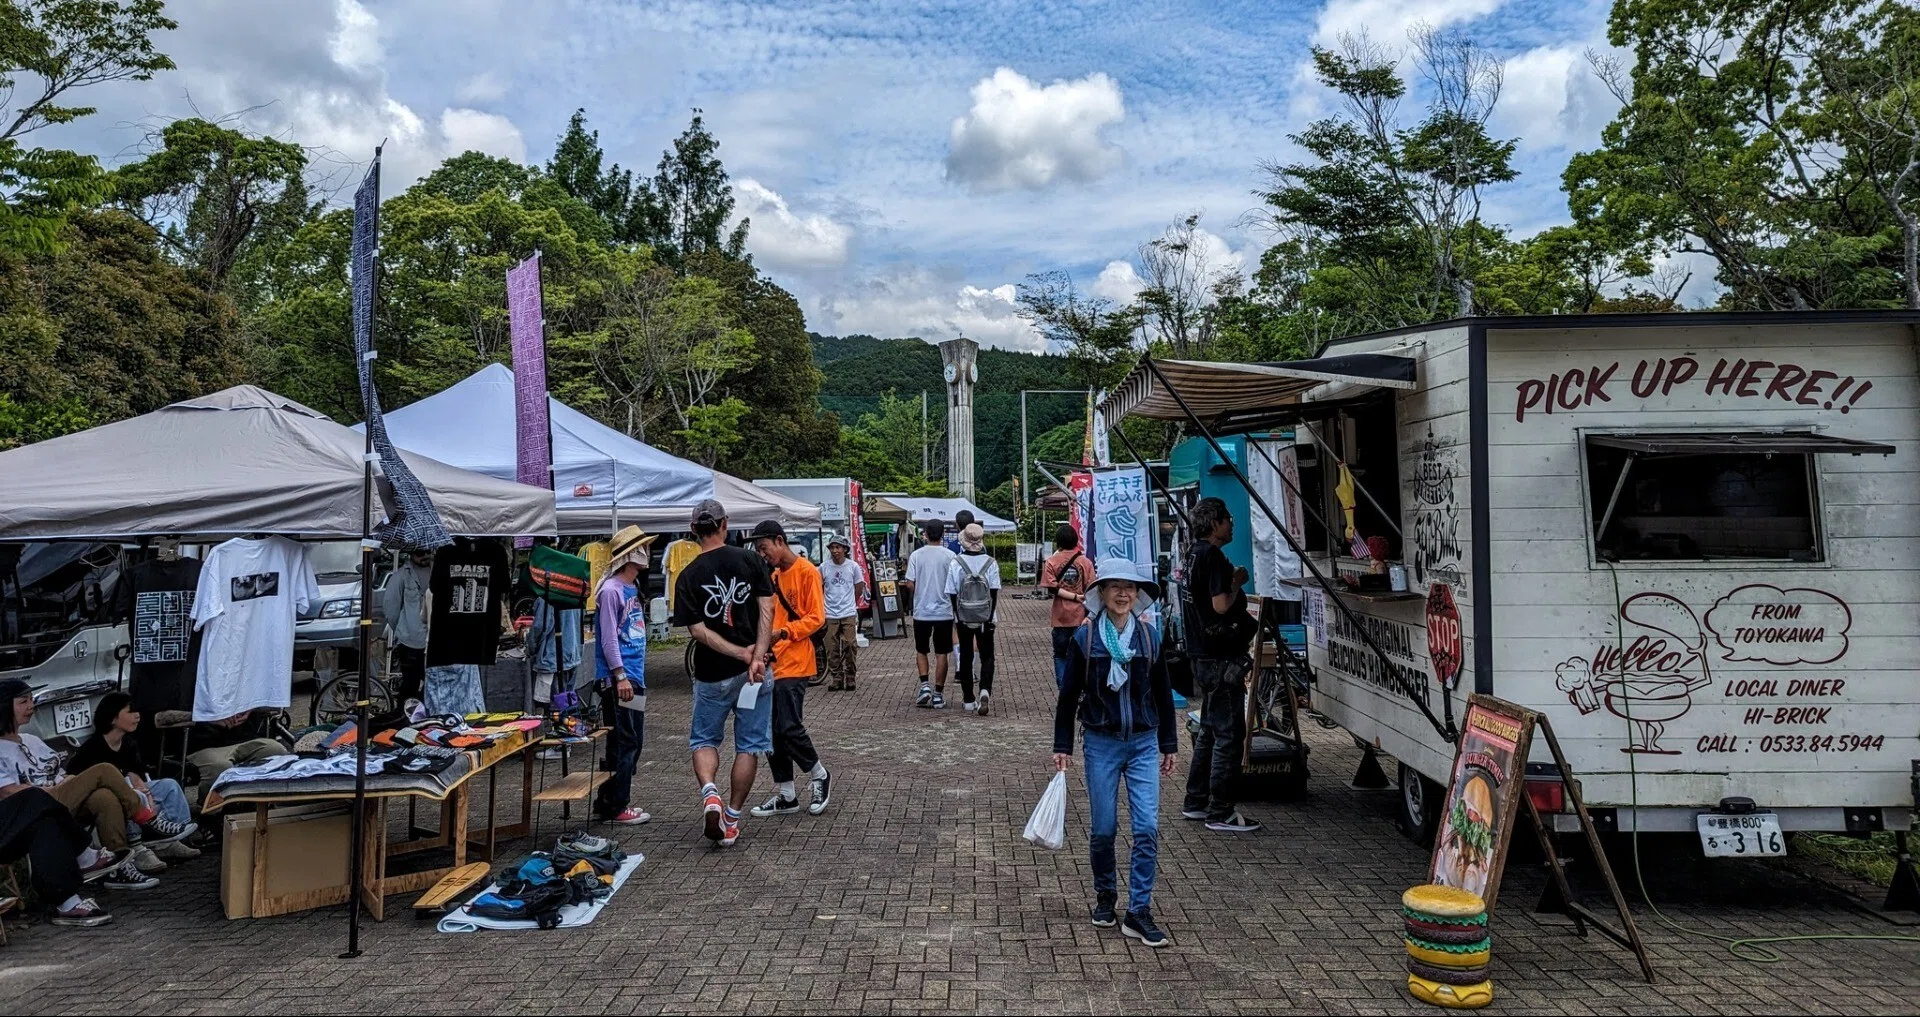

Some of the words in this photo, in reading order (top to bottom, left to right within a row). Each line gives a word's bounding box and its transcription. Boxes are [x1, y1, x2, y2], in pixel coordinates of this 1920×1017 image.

[1516, 361, 1619, 423] PICK
[1630, 357, 1699, 398] UP
[1704, 357, 1874, 415] HERE!!
[1423, 463, 1442, 480] BEST
[454, 564, 491, 573] DAISY
[1751, 604, 1802, 620] FROM
[1368, 617, 1415, 662] ORIGINAL
[1427, 613, 1459, 654] STOP
[1734, 627, 1825, 644] TOYOKAWA
[1327, 640, 1367, 681] DELICIOUS
[1725, 679, 1780, 697] LOCAL
[1785, 678, 1846, 697] DINER
[1744, 707, 1832, 725] HI-BRICK
[1697, 735, 1737, 753] CALL
[1760, 735, 1884, 752] 0533.84.5944
